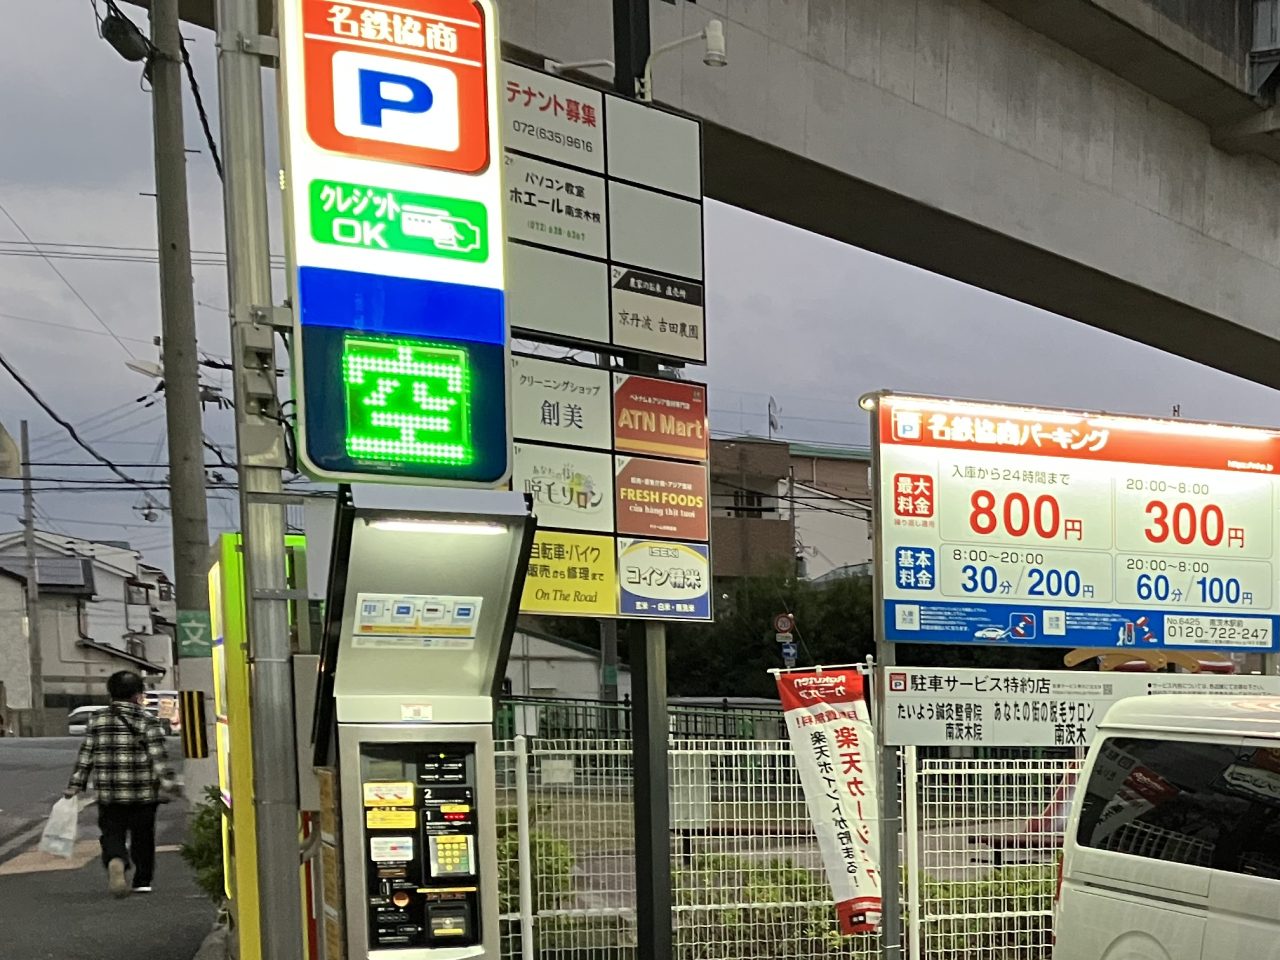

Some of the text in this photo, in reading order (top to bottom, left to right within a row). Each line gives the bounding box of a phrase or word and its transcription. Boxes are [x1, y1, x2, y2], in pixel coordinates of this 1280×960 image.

[326, 4, 458, 53] 名鉄協商
[358, 68, 433, 128] P
[506, 80, 597, 128] テナント募集
[512, 120, 593, 152] 072(635)9616
[525, 172, 586, 199] パソコン教室
[319, 184, 400, 221] クレジット
[332, 217, 389, 249] OK
[618, 309, 699, 340] 京丹波 吉田農園
[519, 374, 601, 397] クリーニングショップ
[347, 345, 465, 460] 空
[540, 399, 583, 429] 創美
[617, 407, 704, 440] ATN Mart
[902, 424, 914, 435] P
[927, 413, 1110, 452] 名鉄協商パーキング
[896, 476, 931, 495] 最大
[951, 464, 1072, 486] 入庫から24時間まで
[619, 487, 704, 508] FRESH FOODS
[897, 496, 931, 515] 料金
[969, 489, 1083, 542] 800円
[1144, 499, 1245, 549] 300円
[530, 542, 601, 563] 自転車・バイク
[898, 549, 932, 568] 基本
[527, 563, 605, 581] 販売から修理まで
[626, 566, 701, 590] コイン精米
[899, 569, 932, 588] 料金
[535, 588, 598, 603] On The Road
[181, 619, 210, 647] 文
[1166, 617, 1200, 626] No.6425
[1167, 626, 1269, 641] 0120-722-247
[910, 674, 1051, 695] 駐車サービス特約店
[897, 702, 983, 721] たいよう鍼灸整骨院
[993, 700, 1096, 723] あなたの街の脱毛サロン
[945, 722, 983, 742] 南茨木院
[1054, 723, 1087, 746] 南茨木
[424, 788, 432, 799] 2
[425, 811, 431, 821] 1
